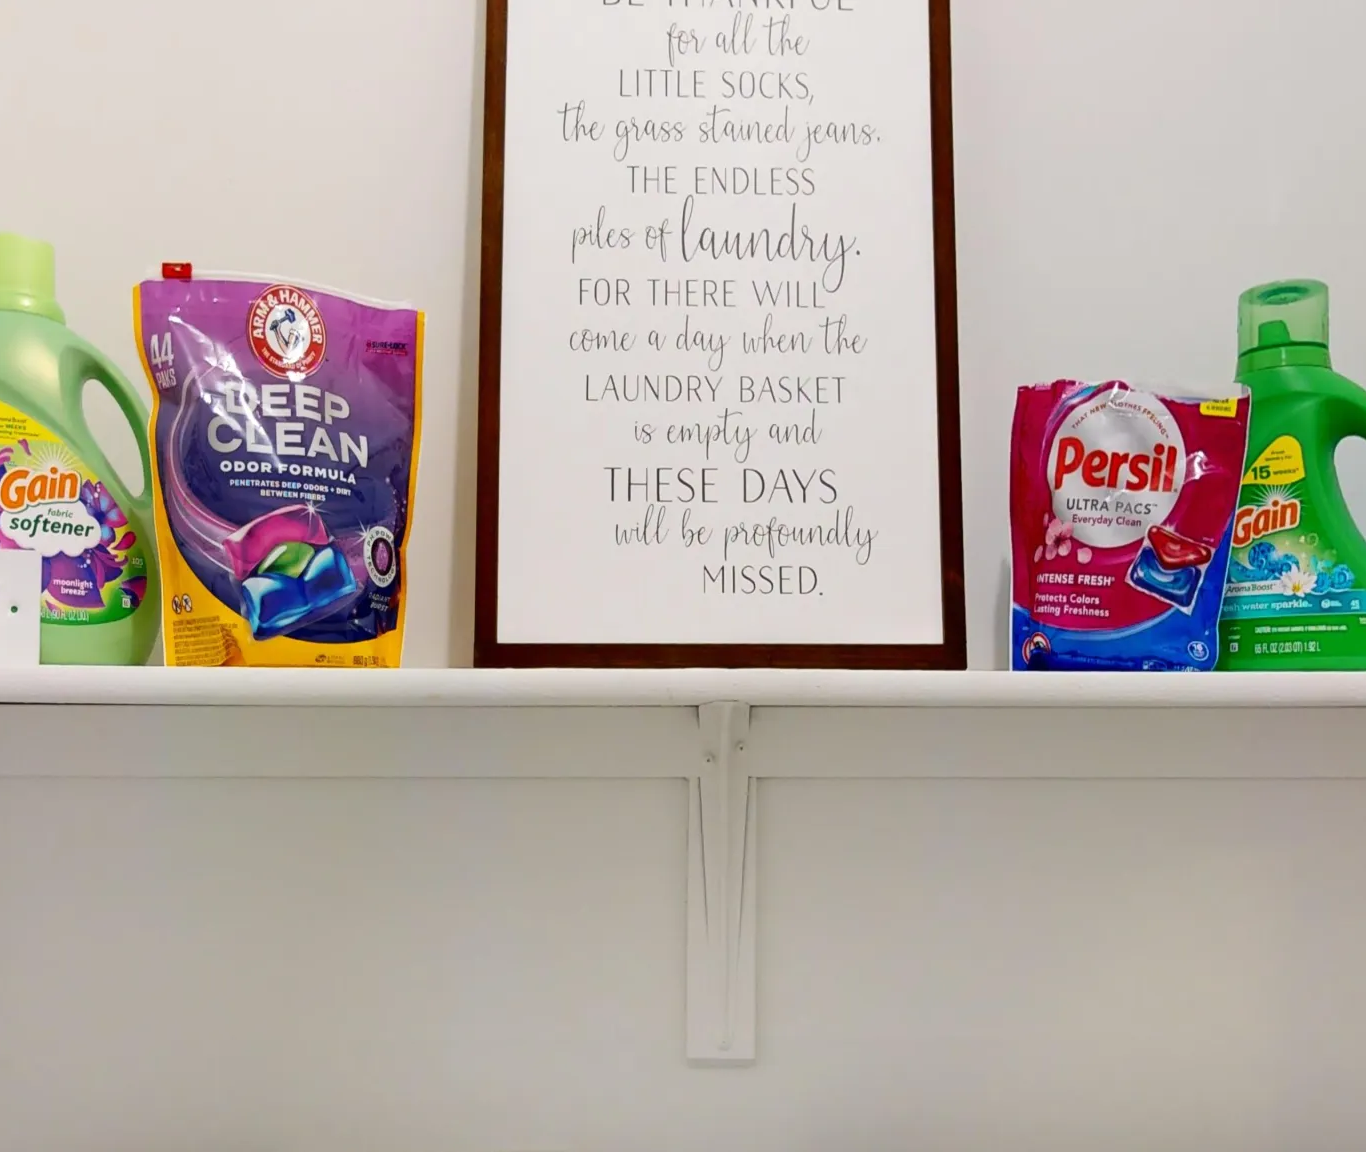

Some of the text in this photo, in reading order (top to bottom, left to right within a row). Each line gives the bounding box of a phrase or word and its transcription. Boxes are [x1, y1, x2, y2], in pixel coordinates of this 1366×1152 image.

[667, 12, 811, 67] for all the
[619, 69, 815, 105] LITTLE SOCKS,
[556, 100, 882, 162] the grass stained jeans.
[626, 166, 816, 196] THE ENDLESS
[571, 194, 861, 293] piles of laundry.
[579, 279, 825, 309] FOR THERE WILL
[252, 289, 323, 345] ARM & HAMMER
[149, 331, 175, 369] 44
[568, 313, 868, 372] come a day when the
[156, 367, 177, 389] PAKS
[585, 375, 847, 404] LAUNDRY BASKET
[224, 382, 350, 425] DEEP
[1071, 412, 1088, 429] THAT
[1089, 402, 1107, 414] NEW
[207, 415, 369, 469] CLEAN
[634, 408, 822, 463] is empty and
[219, 460, 356, 485] ODOR FORMULA
[1054, 436, 1178, 493] Persil
[1251, 465, 1271, 481] 15
[0, 466, 79, 510] Gain
[229, 479, 280, 489] PENETRATES
[281, 480, 302, 490] DEEP
[303, 483, 329, 493] ODORS
[260, 489, 326, 502] BETWEEN FIBERS
[604, 467, 837, 504] THESE DAYS
[47, 508, 74, 518] fabric
[1066, 497, 1153, 515] ULTRA PACS
[1071, 513, 1142, 528] Everyday Clean
[9, 514, 95, 538] softener
[615, 503, 879, 566] will be profoundly
[1232, 500, 1298, 546] Gain
[53, 578, 93, 590] moonlight
[60, 586, 86, 596] breeze
[702, 565, 824, 596] MISSED.
[1036, 573, 1112, 586] INTENSE FRESH
[1034, 592, 1100, 605] Protects Colors
[1034, 604, 1110, 618] Lasting Freshness
[1242, 602, 1269, 611] water
